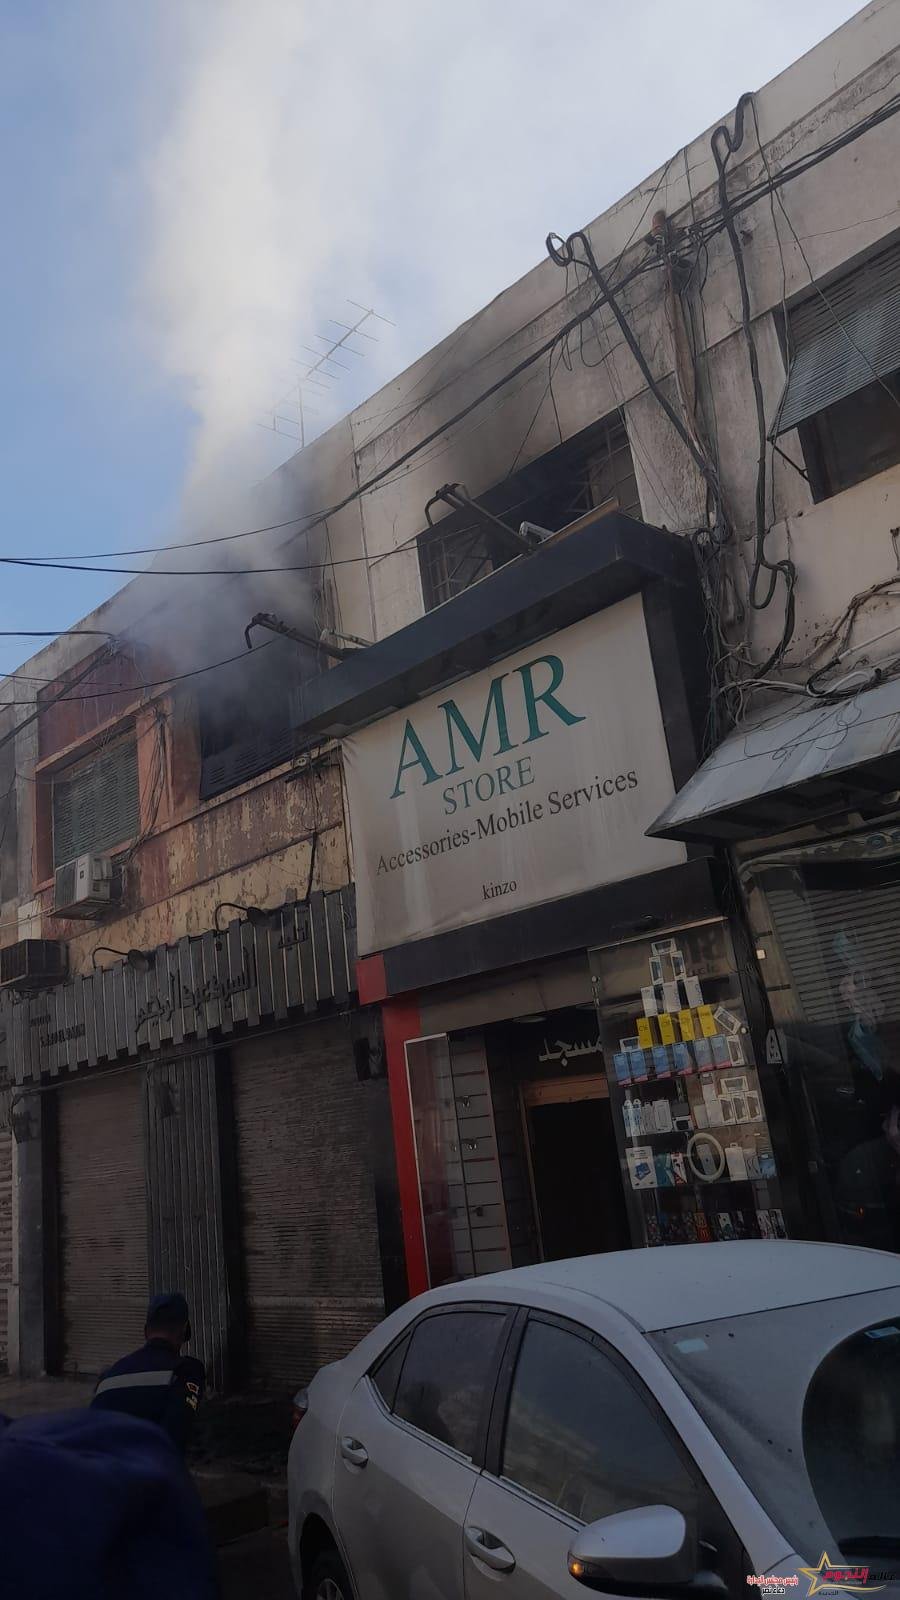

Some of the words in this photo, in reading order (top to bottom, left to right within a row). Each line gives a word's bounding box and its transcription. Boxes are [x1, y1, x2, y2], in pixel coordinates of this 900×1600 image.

[389, 654, 587, 799] AMR
[442, 756, 536, 815] STORE
[549, 769, 639, 815] Services
[482, 878, 518, 900] kinzo
